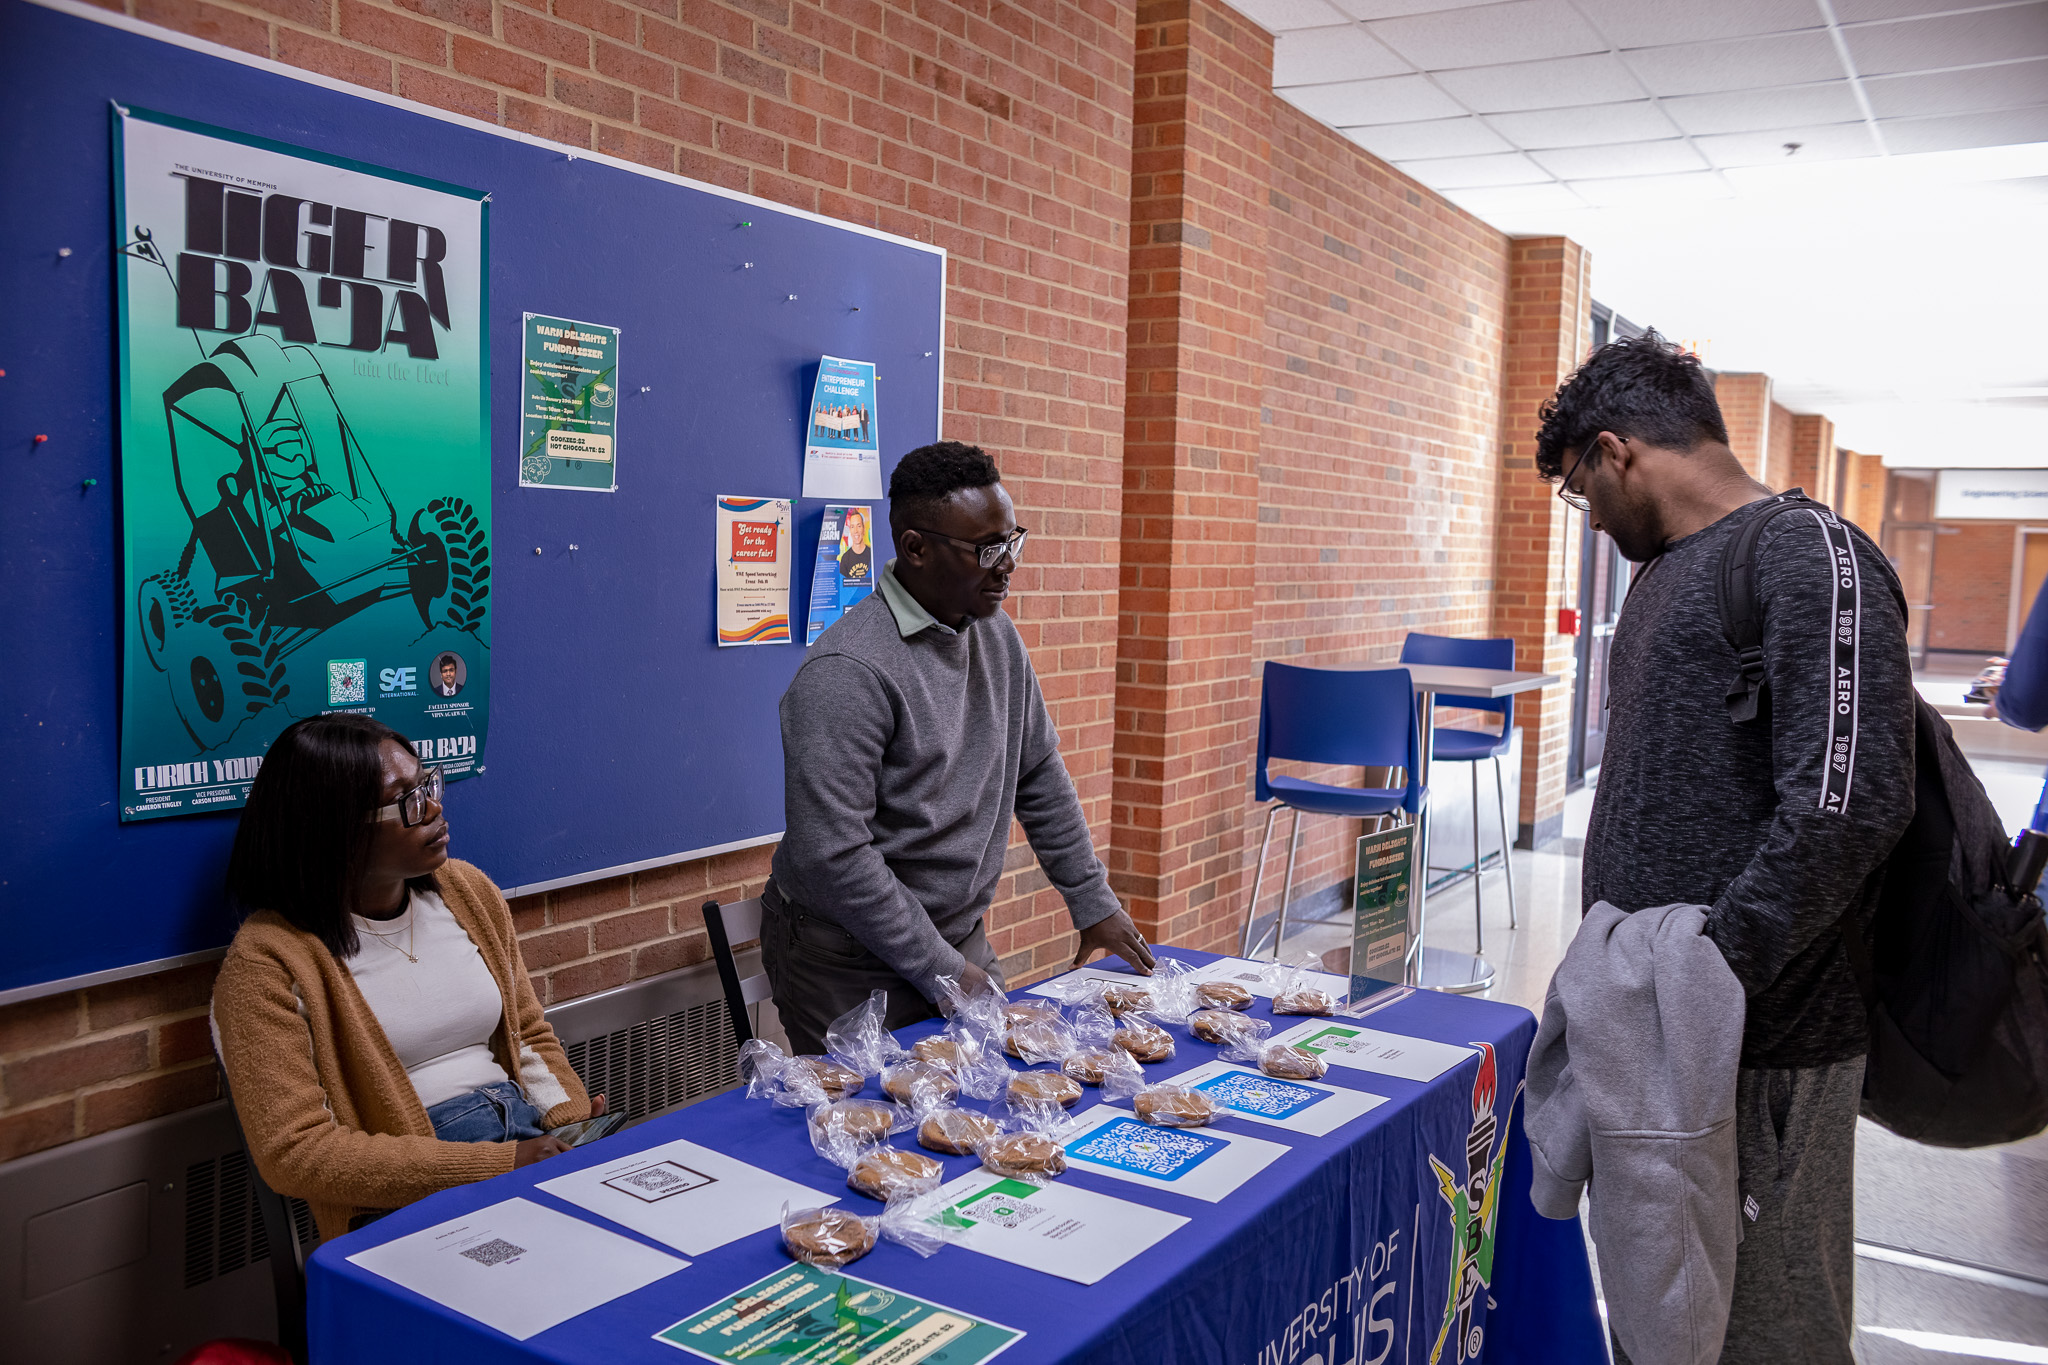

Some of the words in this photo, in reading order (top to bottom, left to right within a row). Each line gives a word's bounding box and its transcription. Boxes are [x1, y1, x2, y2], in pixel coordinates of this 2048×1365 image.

[174, 163, 189, 171] THE
[191, 167, 234, 181] UNIVERSITY
[235, 176, 246, 184] OF
[246, 179, 278, 190] MEMPHIS
[170, 172, 451, 331] TIGER
[177, 252, 439, 360] BAJA
[536, 325, 564, 338] WARM
[564, 330, 608, 345] DELIGHTS
[543, 342, 604, 360] FUNDRAISER
[821, 374, 866, 387] ENTREPRENEUR
[823, 385, 860, 396] CHALLENGE
[562, 445, 597, 453] CHOCOLATE:
[737, 523, 752, 536] Get
[753, 525, 773, 536] ready
[743, 536, 755, 546] for
[755, 536, 766, 545] the
[758, 548, 774, 558] fair!
[1835, 546, 1853, 589] AERO
[1839, 609, 1852, 645] 1987
[379, 666, 417, 692] SAE
[379, 691, 418, 699] INTERNATIONAL
[1838, 666, 1851, 715] AERO
[437, 735, 477, 758] BAJA
[1832, 735, 1849, 773] 1987
[135, 760, 209, 791] ENRICH
[213, 756, 264, 782] YOUR
[454, 760, 475, 768] COORDINATOR
[135, 803, 161, 812] CAMERON
[161, 801, 182, 809] TINGLEY
[212, 795, 237, 803] BRIMHALL
[145, 795, 171, 803] PRESIDENT
[196, 790, 207, 798] VICE
[659, 1182, 690, 1194] venmo
[1370, 1229, 1399, 1281] OF
[688, 1308, 738, 1335] WARM
[732, 1273, 804, 1311] DELIGHTS
[720, 1282, 819, 1336] FUNDRAISER
